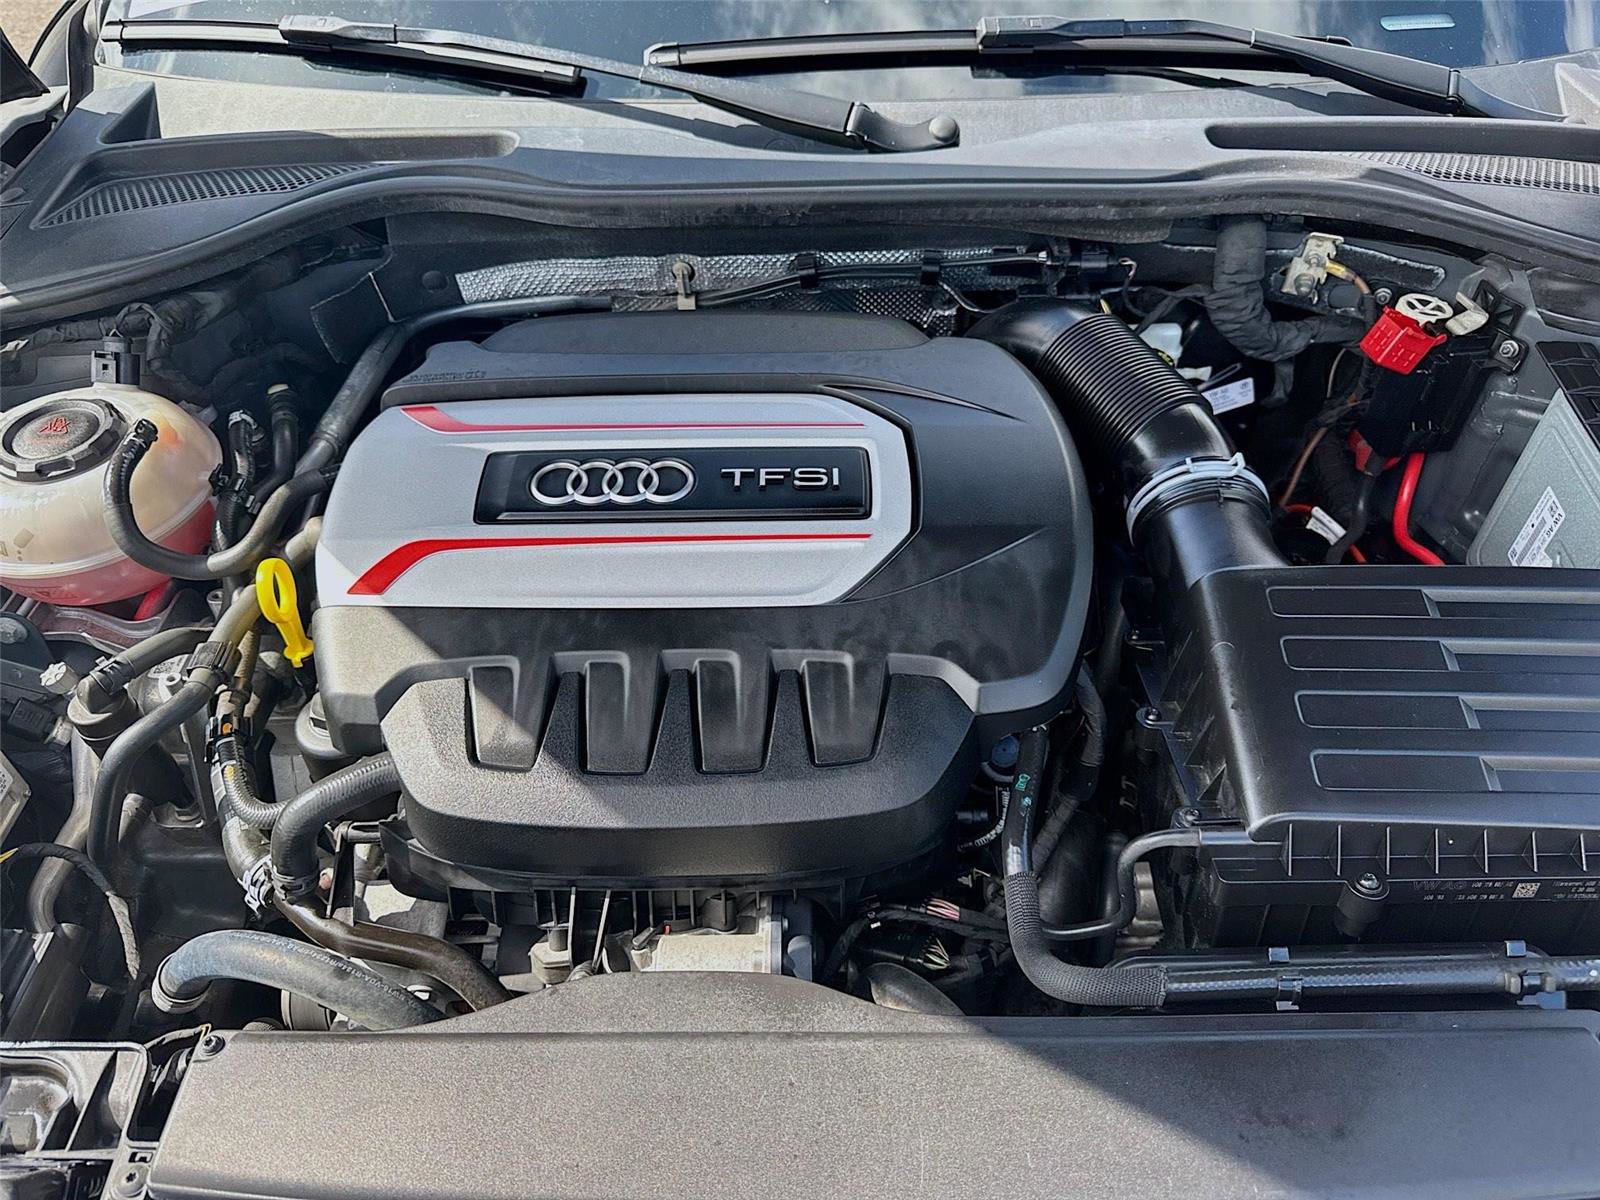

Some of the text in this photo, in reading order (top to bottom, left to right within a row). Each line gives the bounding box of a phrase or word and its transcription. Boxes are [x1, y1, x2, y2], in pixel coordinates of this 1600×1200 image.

[720, 467, 839, 487] TFSI
[1545, 513, 1563, 538] VW AG
[1413, 880, 1441, 890] VW
[1441, 880, 1467, 890] AG
